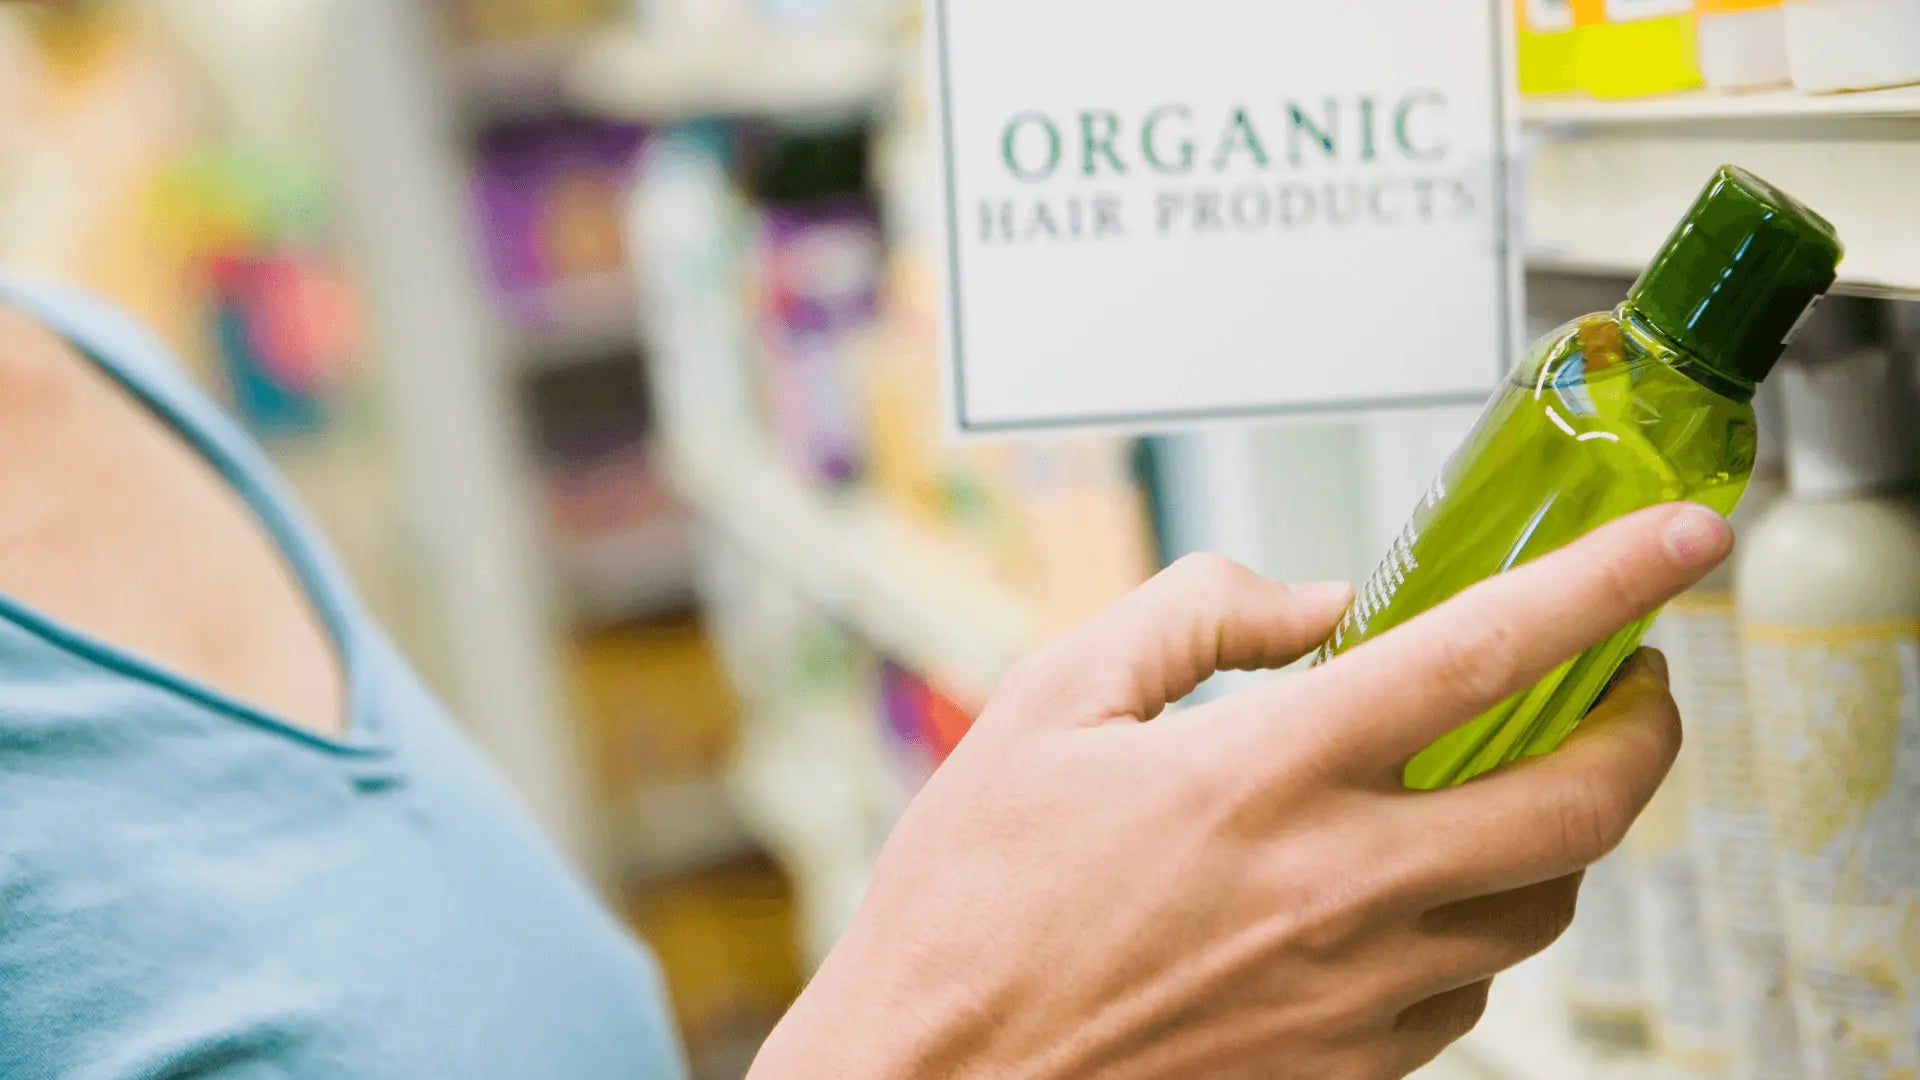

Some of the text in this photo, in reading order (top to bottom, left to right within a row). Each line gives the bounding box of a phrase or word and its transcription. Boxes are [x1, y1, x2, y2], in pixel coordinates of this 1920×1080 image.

[1001, 89, 1451, 181] ORGANIC
[978, 176, 1477, 243] HAIR PRODUCTS
